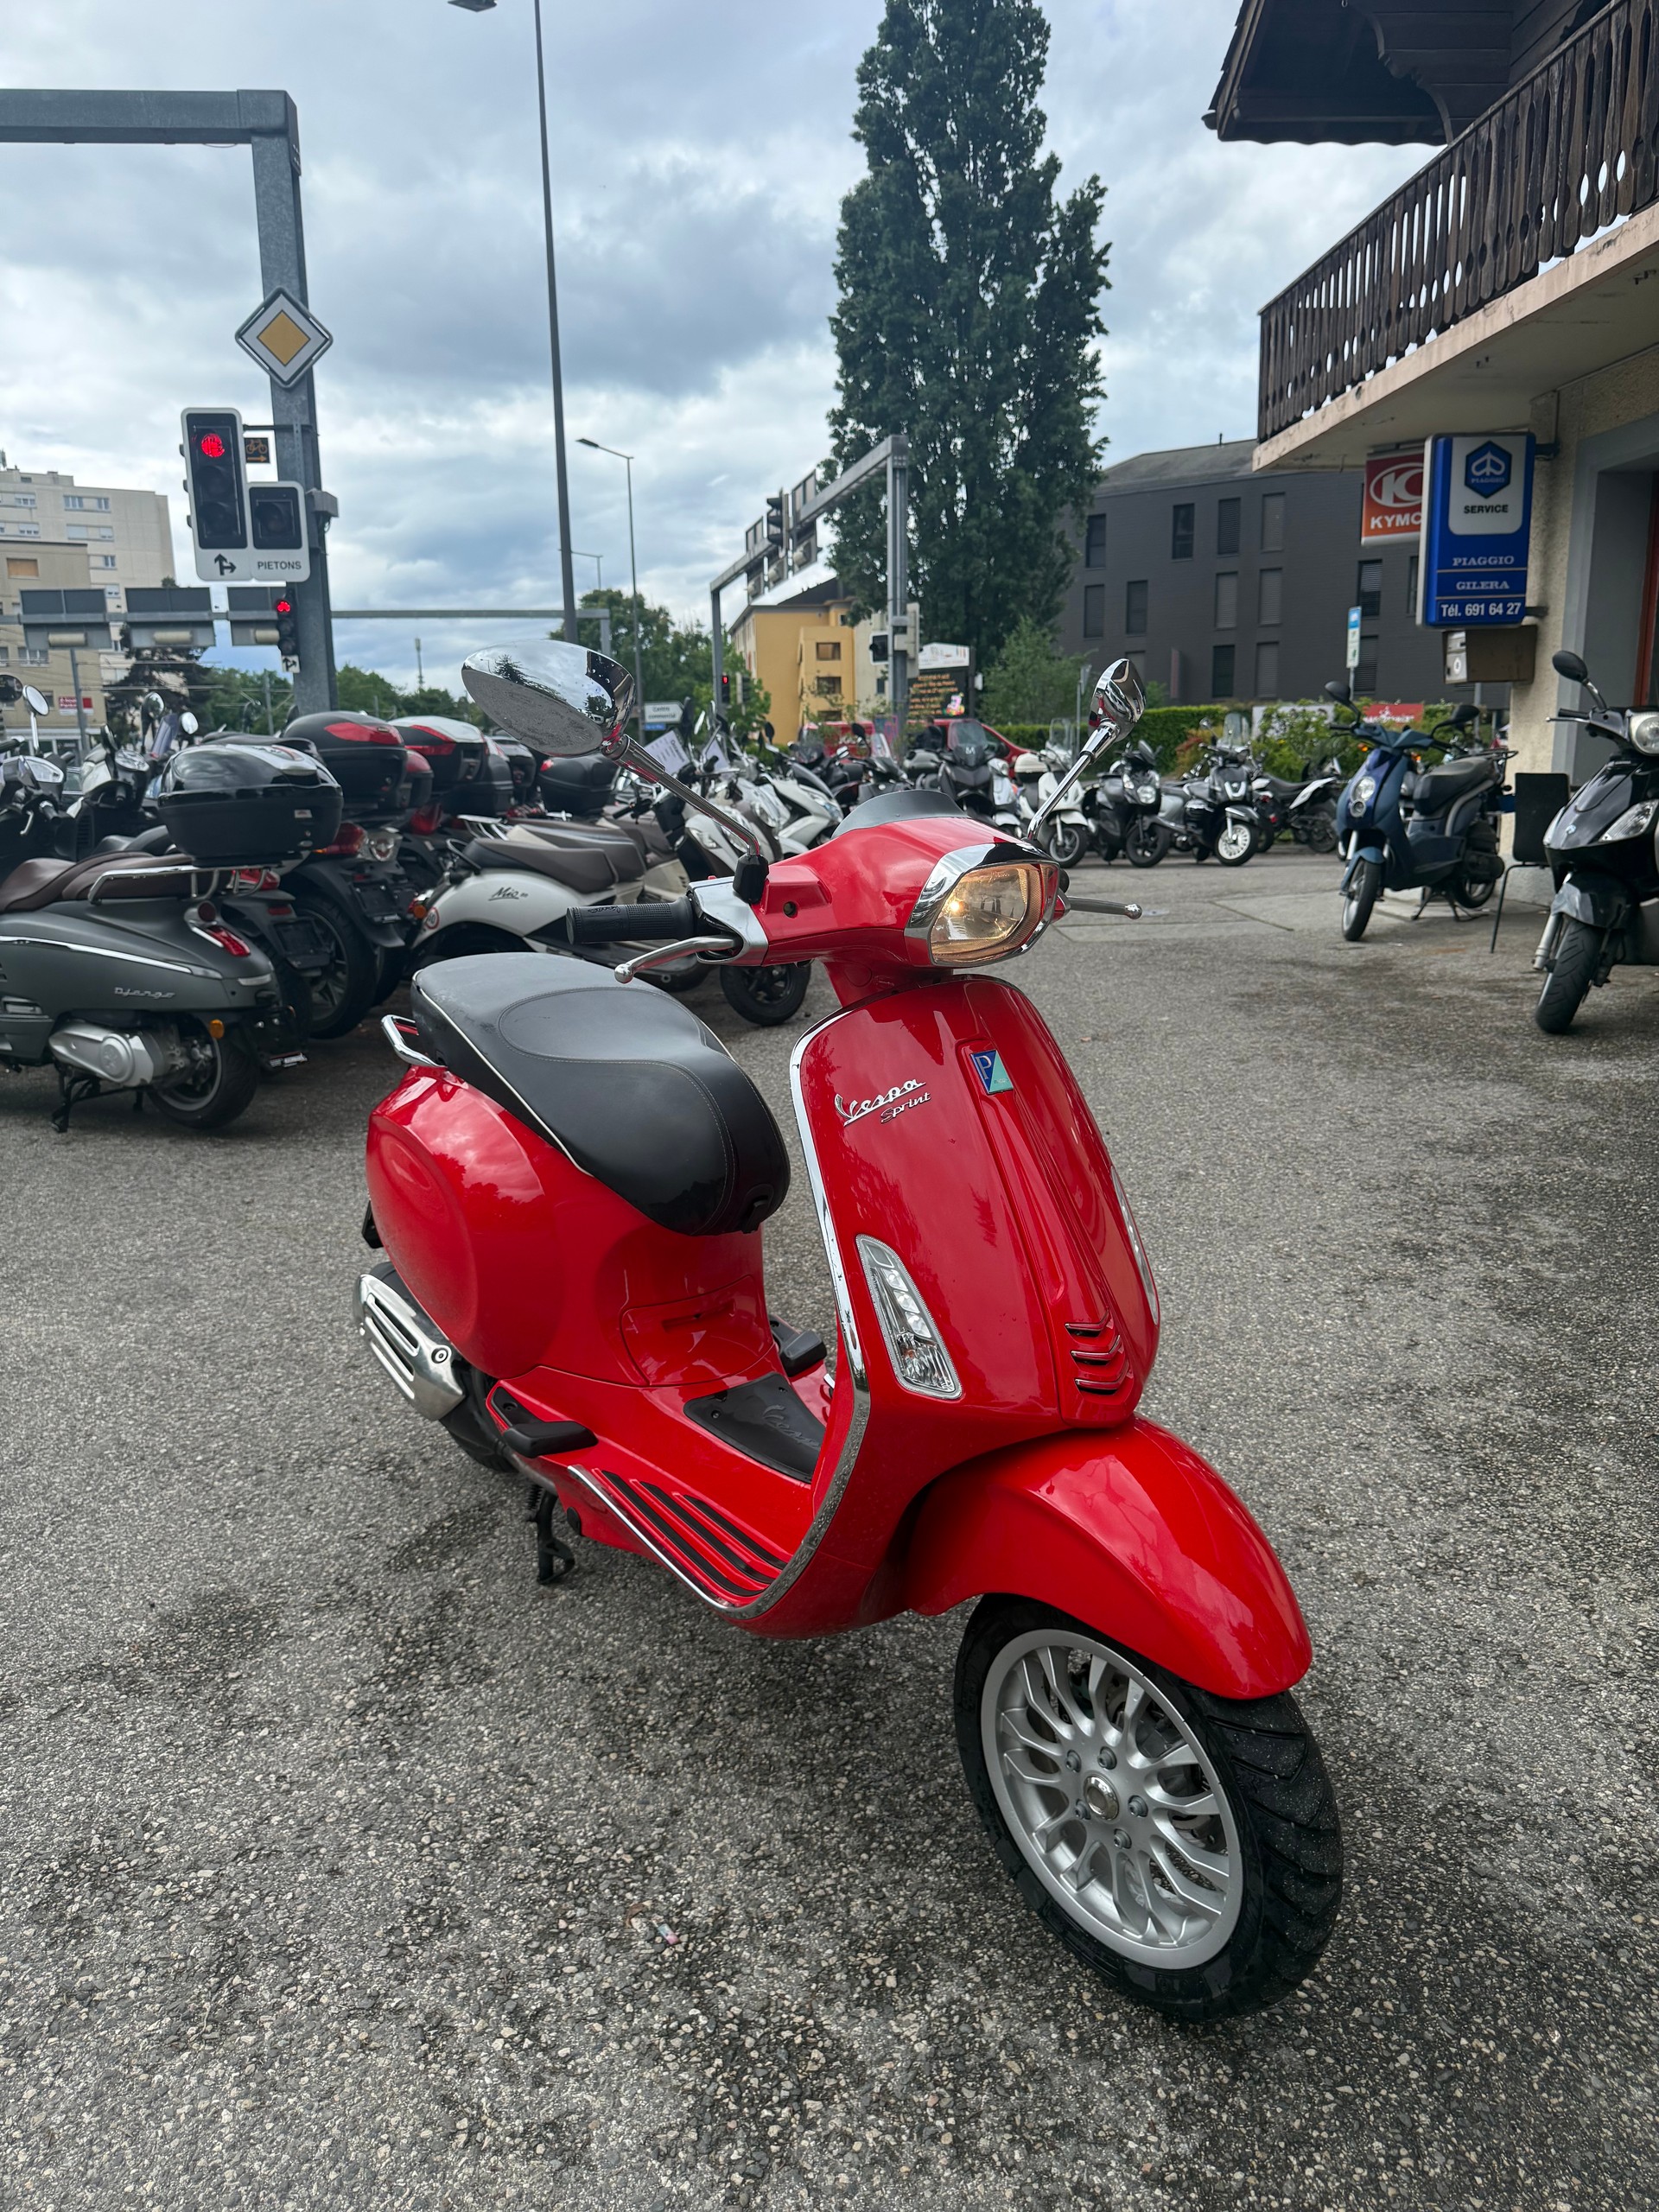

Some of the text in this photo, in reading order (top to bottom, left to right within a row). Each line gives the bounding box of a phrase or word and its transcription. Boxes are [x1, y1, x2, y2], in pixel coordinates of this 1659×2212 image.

[1464, 505, 1509, 514] SERVICE
[1370, 512, 1422, 530] KYMC
[257, 561, 302, 569] PIETONS
[1452, 556, 1515, 566] PIAGGIO
[1456, 581, 1510, 590] GILERA
[1441, 602, 1521, 617] Tél. 691 64 27
[975, 1055, 992, 1080] P
[834, 1078, 926, 1128] Vespa
[880, 1092, 931, 1124] Sprint
[762, 1404, 822, 1452] Vesp
